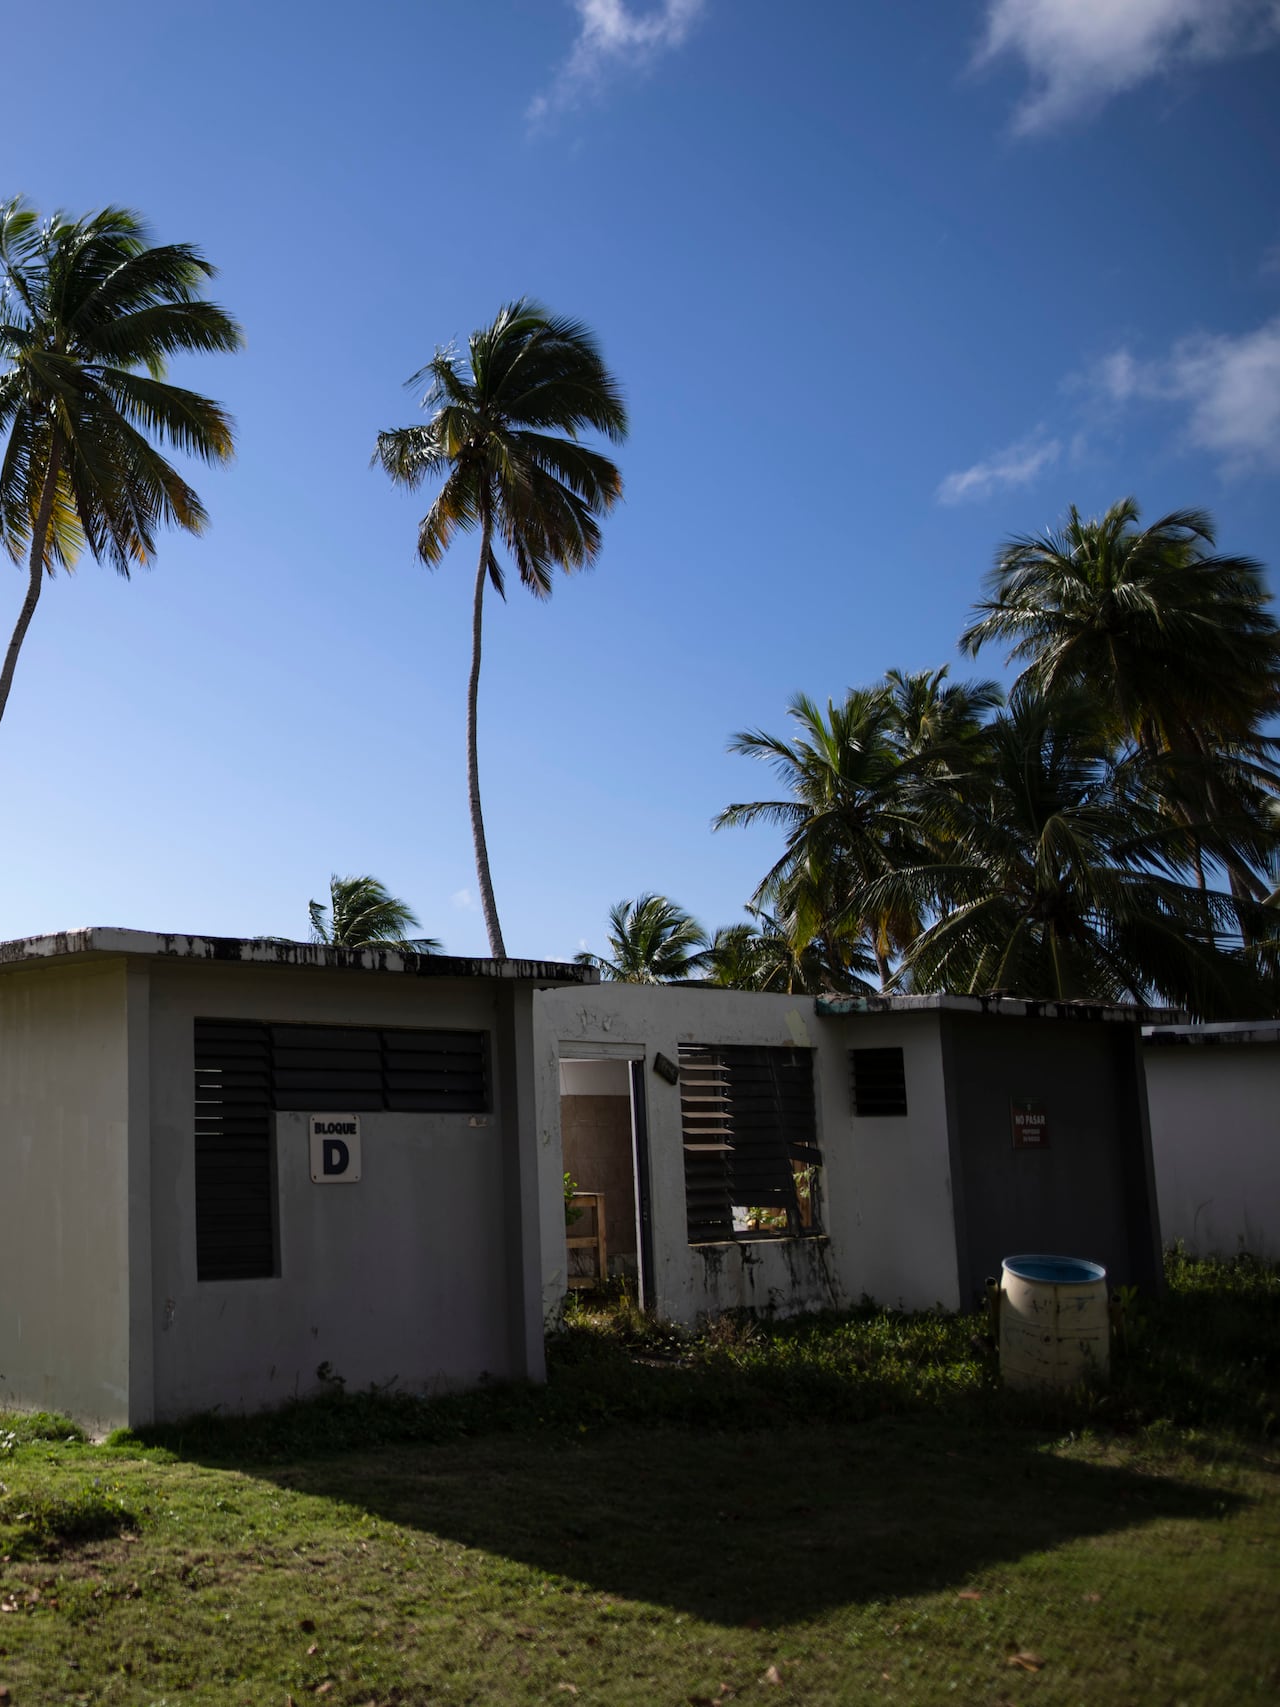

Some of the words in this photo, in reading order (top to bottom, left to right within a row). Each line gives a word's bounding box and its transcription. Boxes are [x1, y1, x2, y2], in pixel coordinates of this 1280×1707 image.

[1015, 1114, 1025, 1125] NO
[1025, 1114, 1045, 1125] PASAR
[314, 1122, 357, 1135] BLOQUE
[323, 1139, 349, 1175] D
